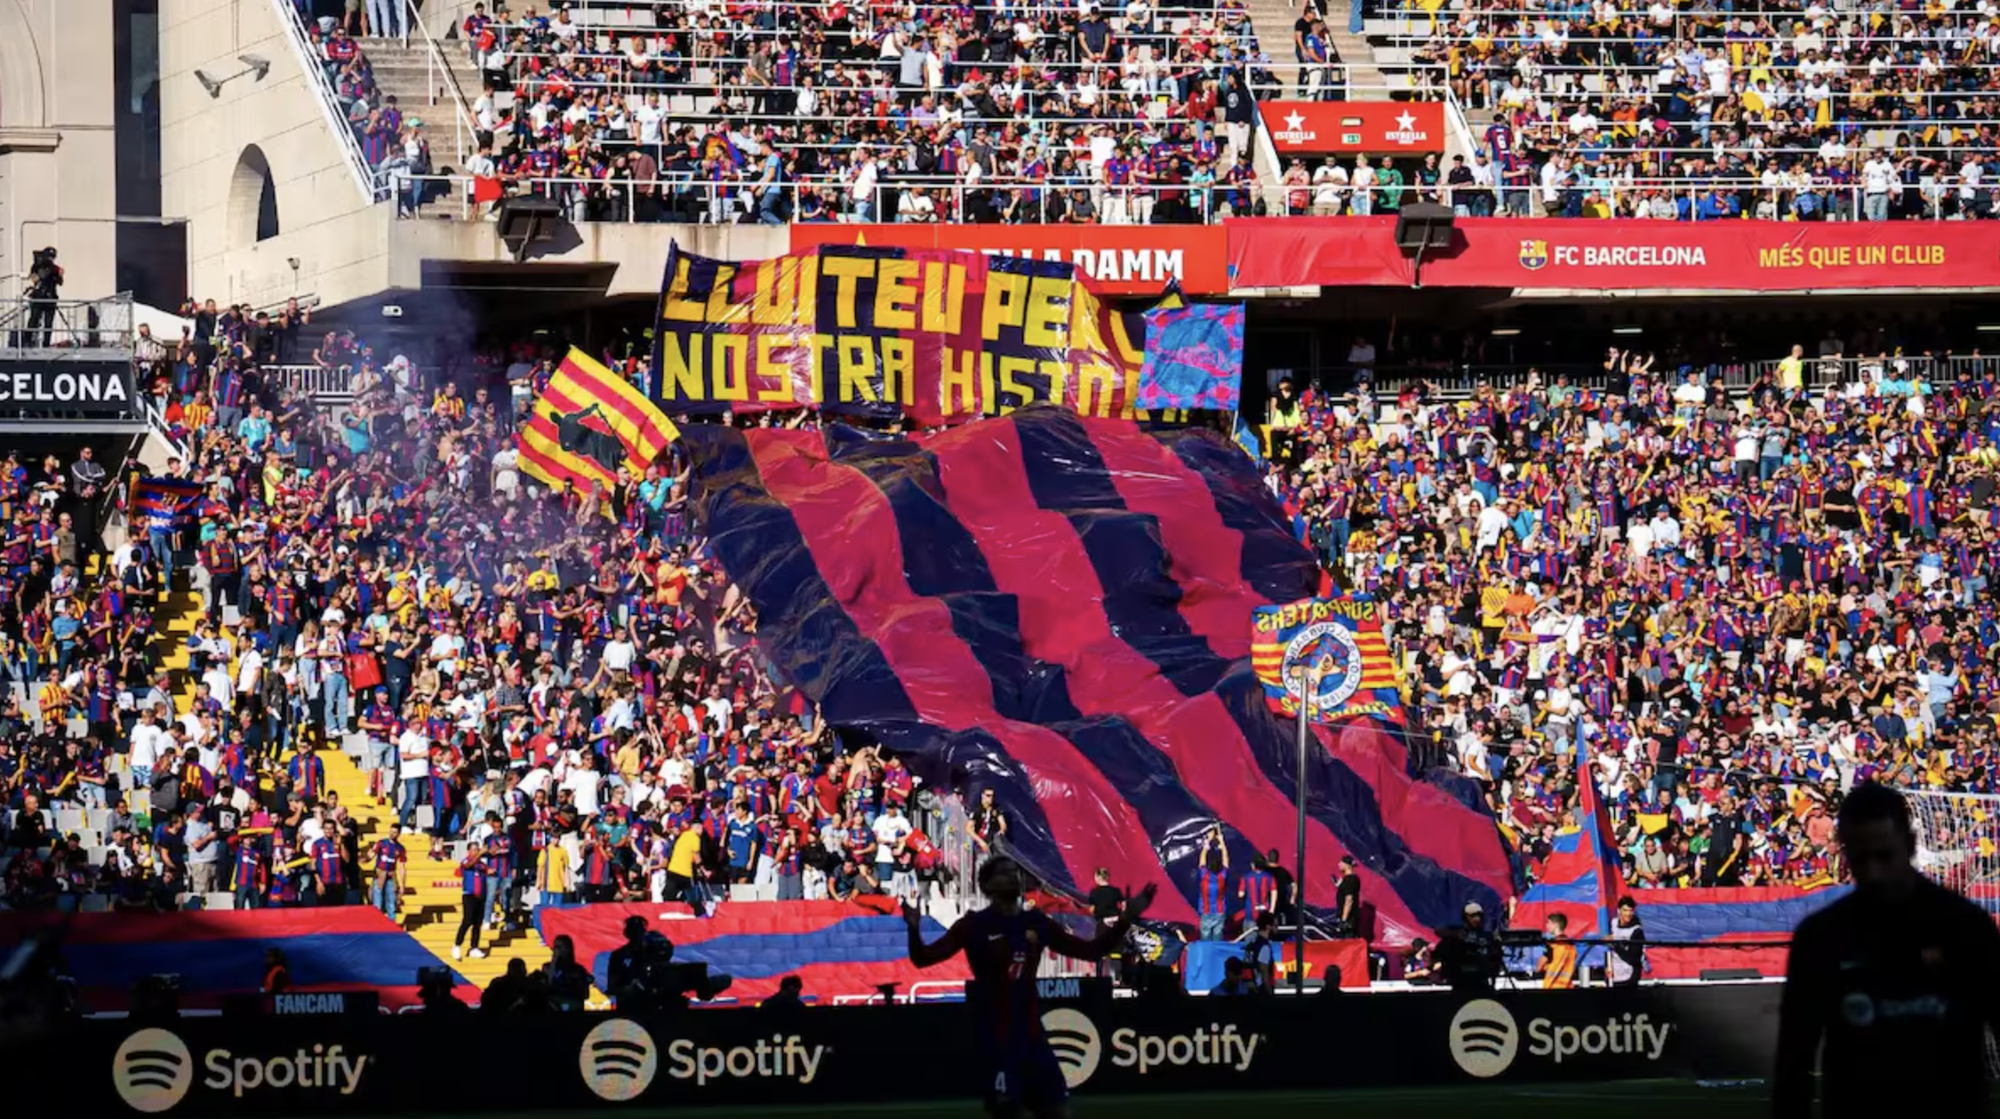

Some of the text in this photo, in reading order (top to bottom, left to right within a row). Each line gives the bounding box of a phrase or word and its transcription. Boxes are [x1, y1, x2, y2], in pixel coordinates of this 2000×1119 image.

[1074, 249, 1184, 281] DAMM
[1554, 246, 1706, 266] FC BARCELONA
[1759, 243, 1945, 269] MÉS QUE UN CLUB
[662, 331, 914, 406] NOSTRA
[275, 994, 344, 1014] FANCAM
[1036, 979, 1080, 998] NCAM
[1112, 1023, 1258, 1074] Spotify
[1528, 1013, 1670, 1063] Spotify
[204, 1043, 367, 1097] Spotify
[668, 1034, 823, 1086] Spotify
[995, 1071, 1007, 1093] 4
